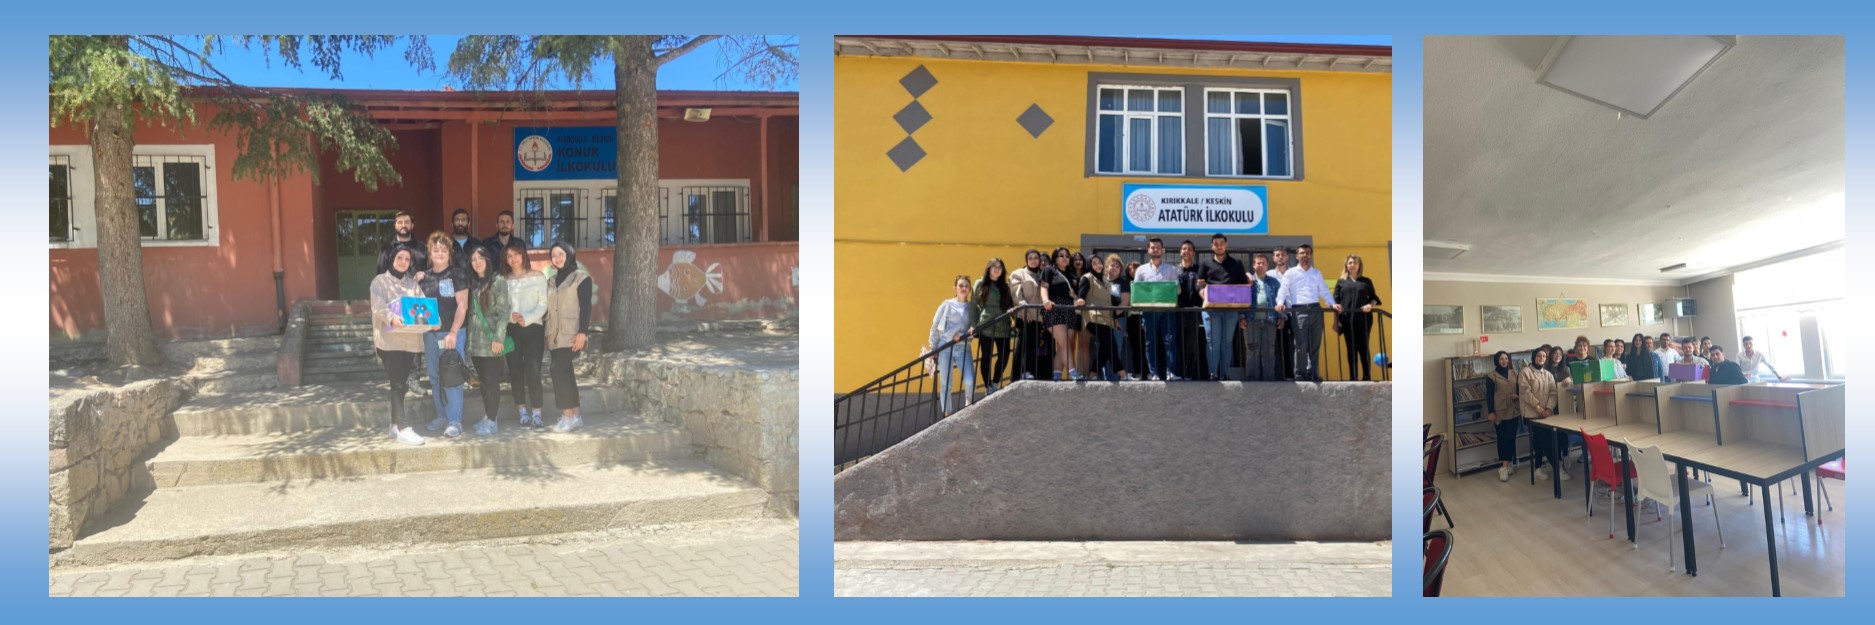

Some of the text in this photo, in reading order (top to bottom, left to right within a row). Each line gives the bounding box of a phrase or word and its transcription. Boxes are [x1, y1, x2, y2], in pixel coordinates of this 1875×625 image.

[557, 146, 599, 157] KONUR
[556, 159, 616, 172] İLKOKULU
[1161, 197, 1199, 205] KIRIKKALE
[1205, 196, 1232, 205] KESKİN
[1158, 206, 1254, 223] ATATÜRK İLKOKULU
